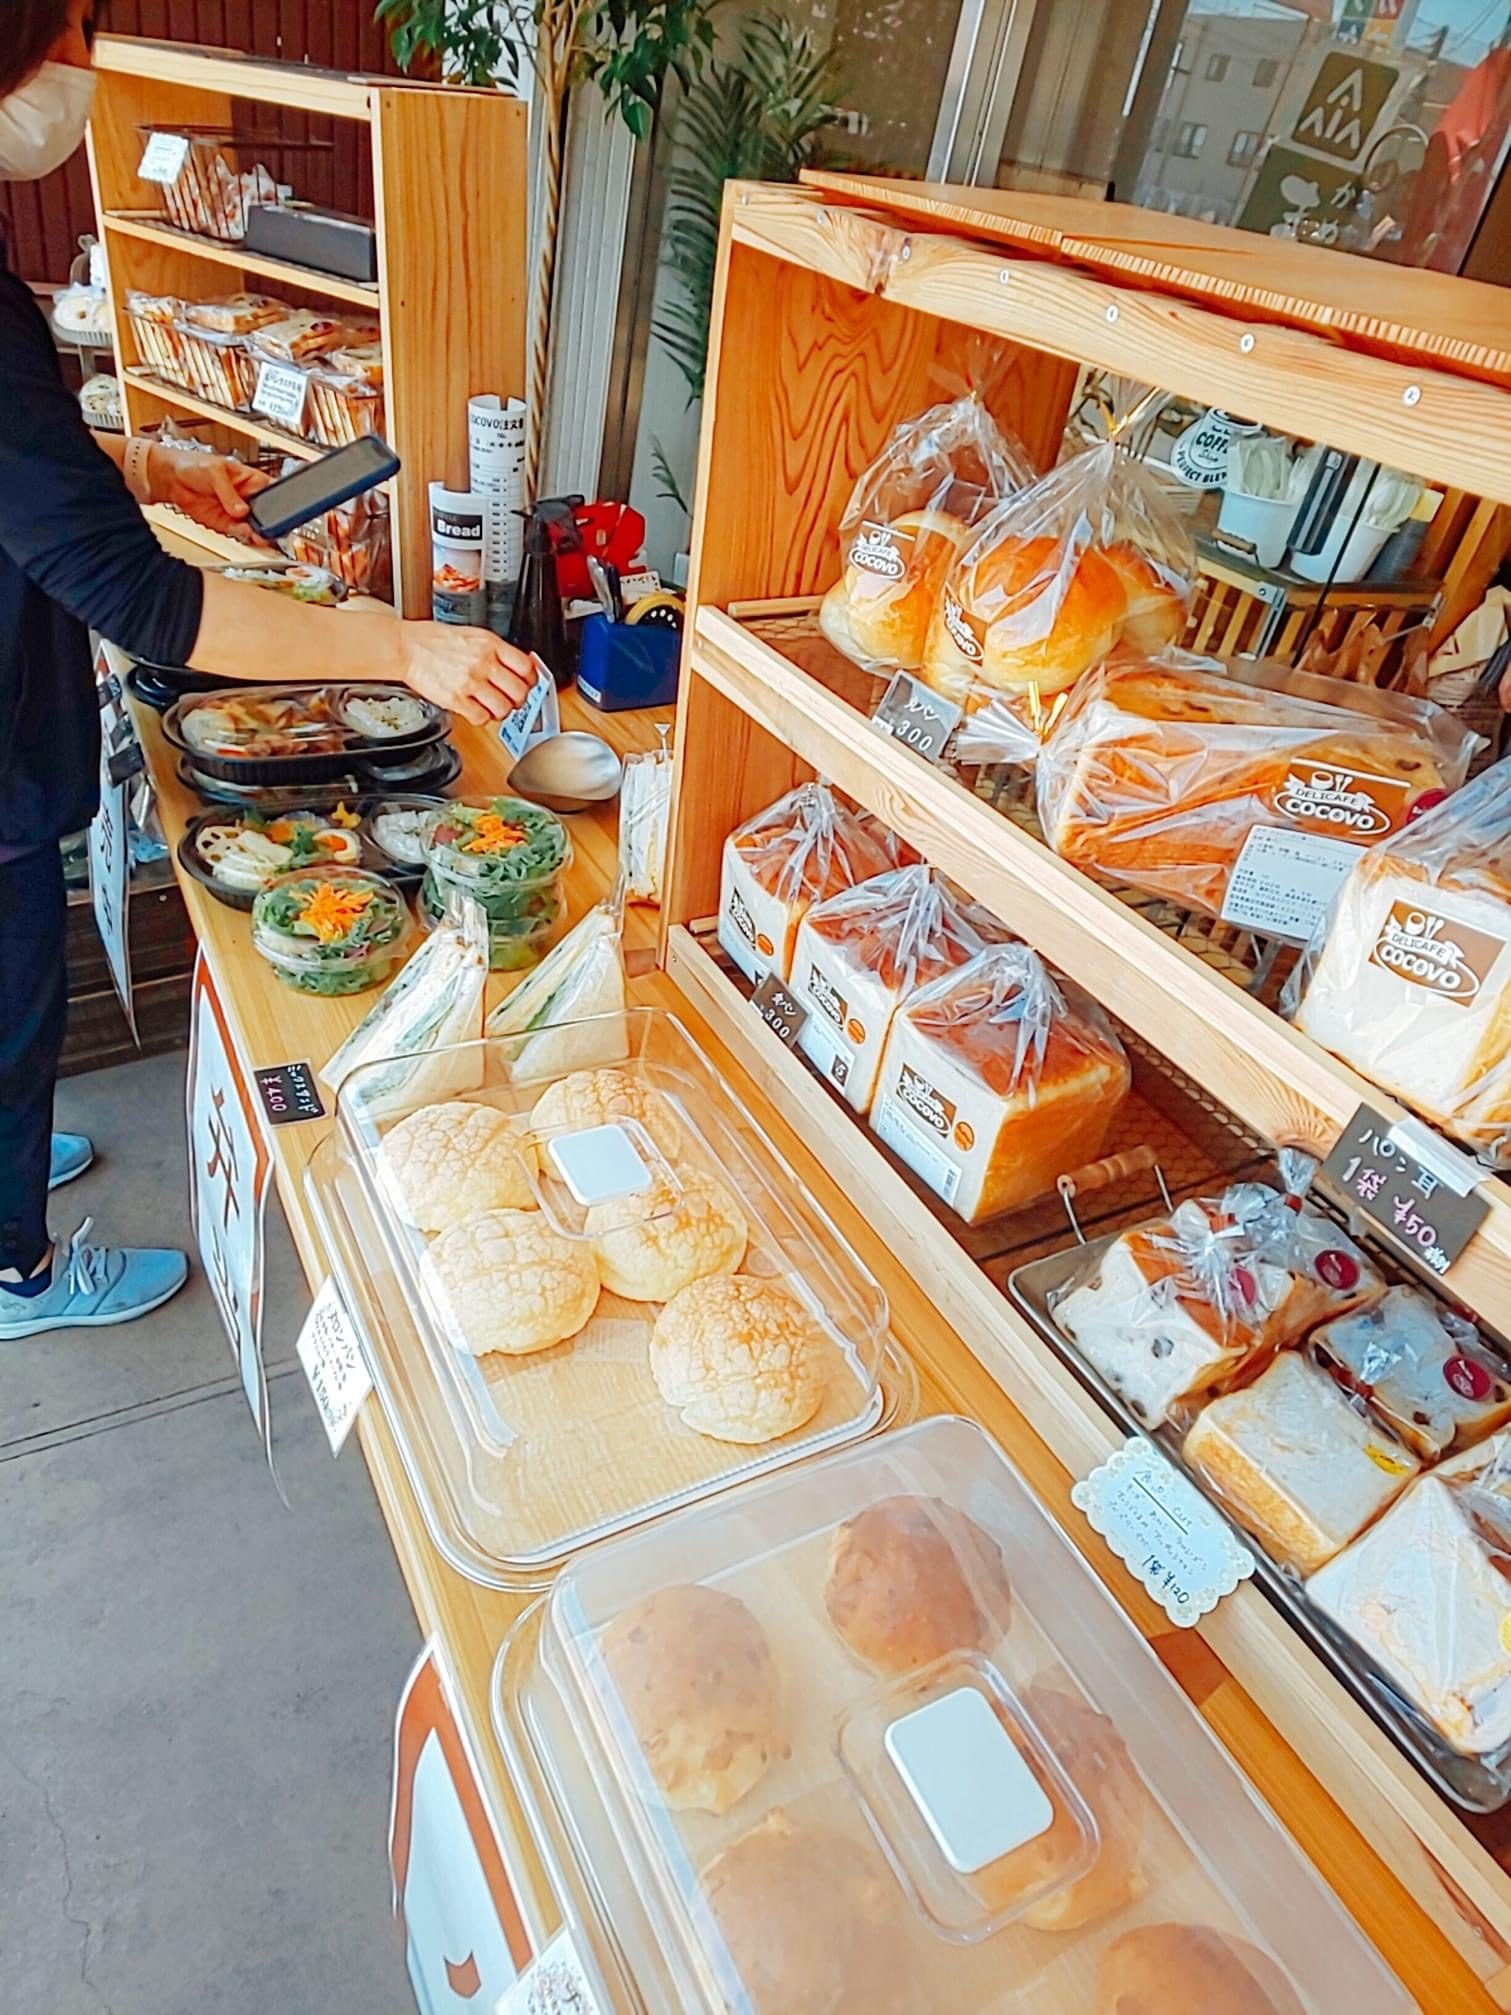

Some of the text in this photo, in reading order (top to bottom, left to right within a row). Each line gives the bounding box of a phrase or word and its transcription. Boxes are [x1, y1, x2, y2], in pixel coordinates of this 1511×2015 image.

[436, 518, 480, 537] Bread
[854, 552, 898, 575] COCOVO
[1295, 787, 1360, 807] DELICAFE
[1285, 798, 1376, 830] COCOVO
[1391, 932, 1446, 959] DELICAFE
[1380, 944, 1462, 990] COCOVO
[764, 1008, 791, 1039] 300
[260, 1075, 287, 1111] ¥400
[902, 1088, 944, 1129] COCOVO
[1393, 1195, 1437, 1247] ¥50
